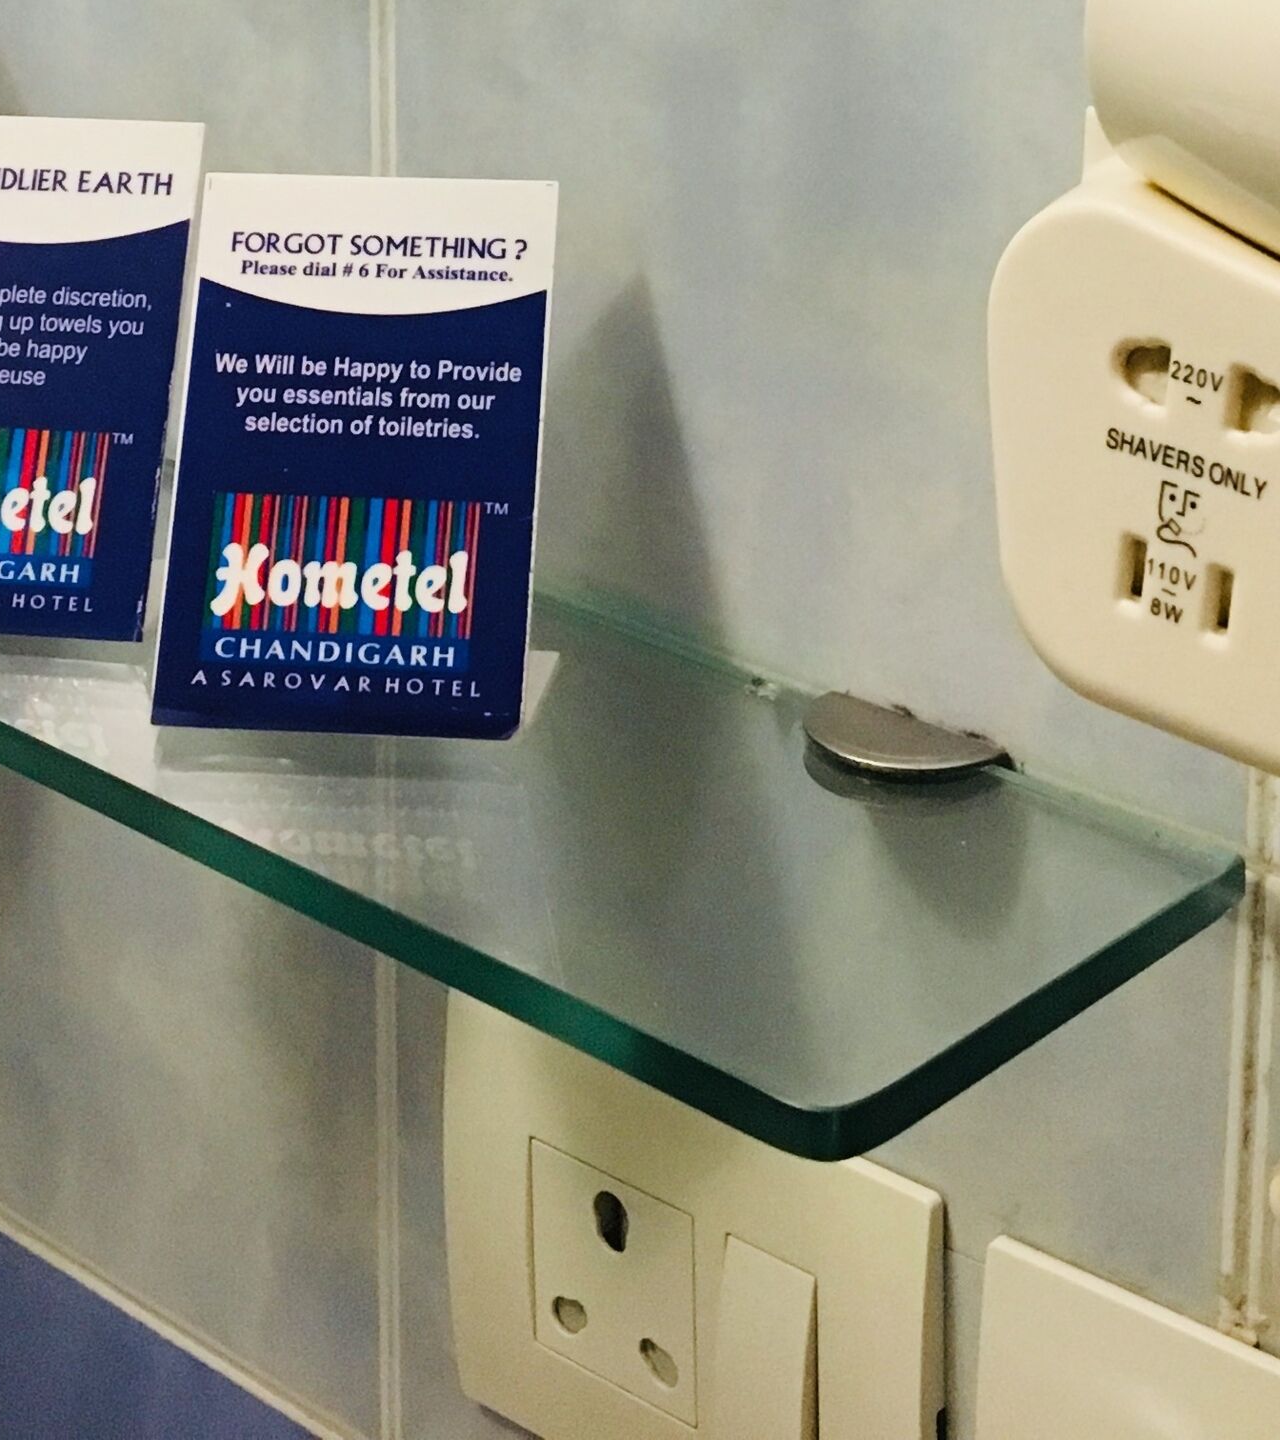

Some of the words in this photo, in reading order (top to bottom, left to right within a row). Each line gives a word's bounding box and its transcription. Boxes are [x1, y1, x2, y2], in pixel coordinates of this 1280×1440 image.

[78, 171, 173, 195] EARTH
[231, 232, 342, 255] FORGOT
[241, 261, 296, 275] Please
[303, 262, 337, 276] dial
[342, 263, 352, 277] #
[359, 263, 369, 277] 6
[376, 264, 407, 278] For
[413, 266, 513, 282] Assistance.
[52, 289, 152, 310] discretion,
[10, 317, 33, 333] up
[40, 316, 102, 333] towels
[107, 320, 144, 339] you
[27, 341, 88, 364] happy
[216, 353, 247, 373] We
[255, 354, 294, 375] Will
[301, 356, 327, 376] be
[334, 357, 402, 383] Happy
[410, 360, 431, 379] to
[438, 360, 521, 382] Provide
[1171, 360, 1223, 392] 220V
[236, 386, 276, 407] you
[283, 386, 392, 406] essentials
[400, 388, 450, 408] from
[458, 394, 495, 410] our
[245, 412, 343, 434] selection
[350, 415, 374, 435] of
[379, 415, 479, 439] toiletries.
[1106, 428, 1205, 478] SHAVERS
[1209, 462, 1267, 499] ONLY
[210, 543, 468, 616] Hometel
[1148, 558, 1196, 591] 110V
[12, 592, 92, 612] HOTEL
[1150, 598, 1183, 623] 8W
[215, 637, 455, 667] CHANDIGARH
[191, 670, 207, 685] A
[221, 671, 371, 692] SAROVAR
[385, 678, 480, 698] HOTEL
